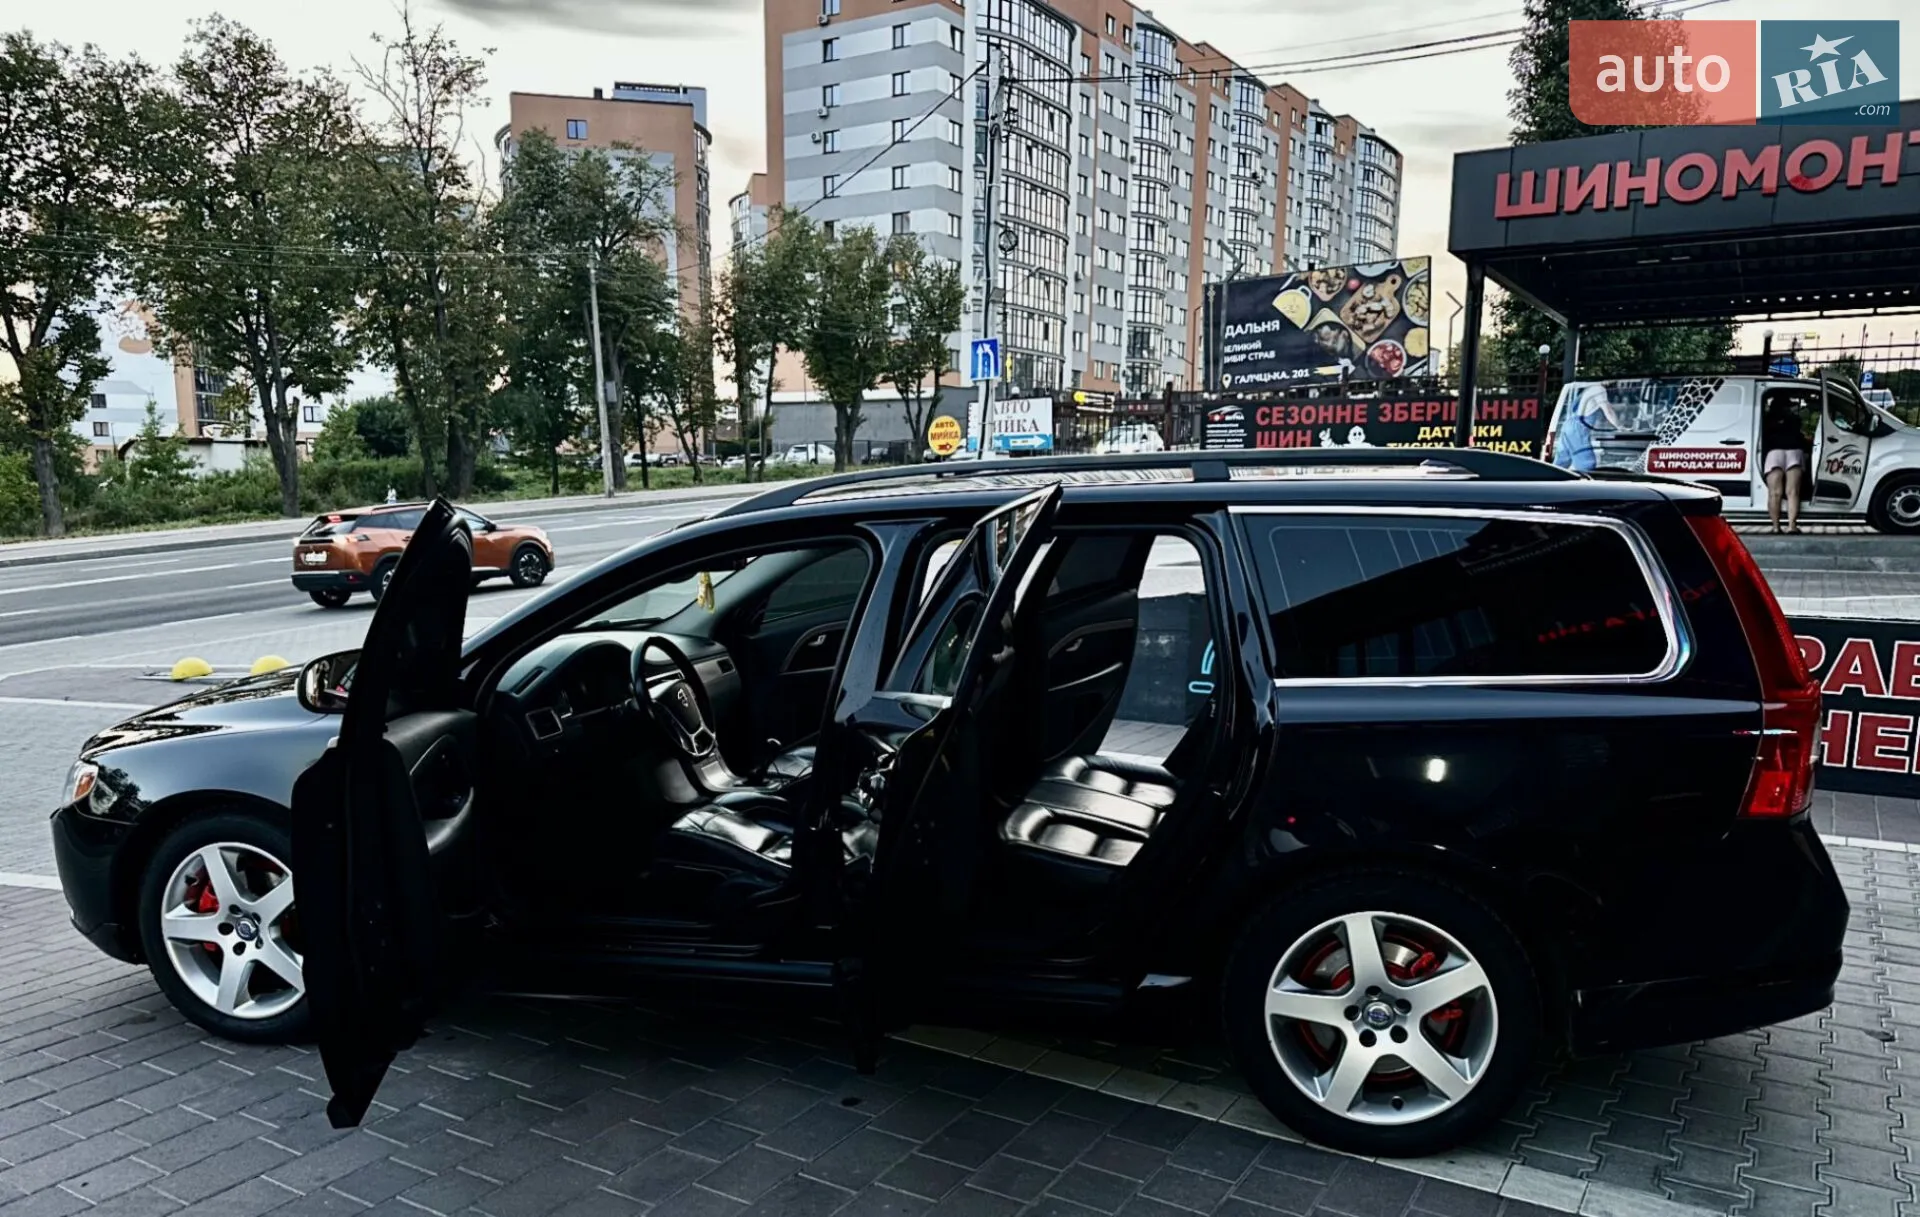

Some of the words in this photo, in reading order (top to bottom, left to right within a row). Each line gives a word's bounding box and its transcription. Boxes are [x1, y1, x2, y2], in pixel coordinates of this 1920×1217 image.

[1494, 131, 1920, 219] ШИНОМОН
[1292, 368, 1310, 378] 201
[1255, 403, 1368, 426] СЕЗОННЕ
[1256, 430, 1312, 448] ШИН
[1659, 452, 1737, 460] ШИНОМОНТАЖ
[1653, 461, 1666, 469] ТА
[1667, 461, 1714, 470] ПРОДАЖ
[1716, 461, 1742, 469] ШИН
[1821, 709, 1920, 774] НЕ
